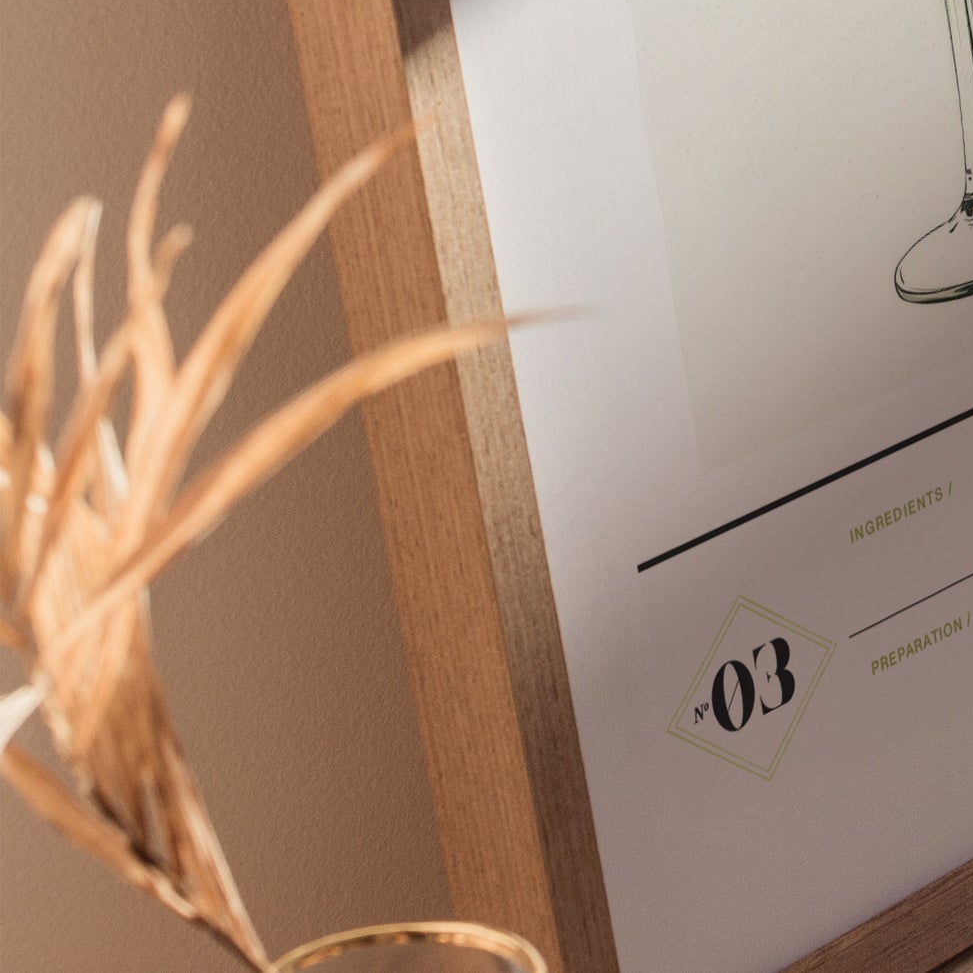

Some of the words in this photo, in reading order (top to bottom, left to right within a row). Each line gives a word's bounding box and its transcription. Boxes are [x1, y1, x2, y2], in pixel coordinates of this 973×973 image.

[849, 487, 944, 544] INGREDIENTS
[870, 616, 963, 675] PREPARATION
[711, 636, 796, 732] 03
